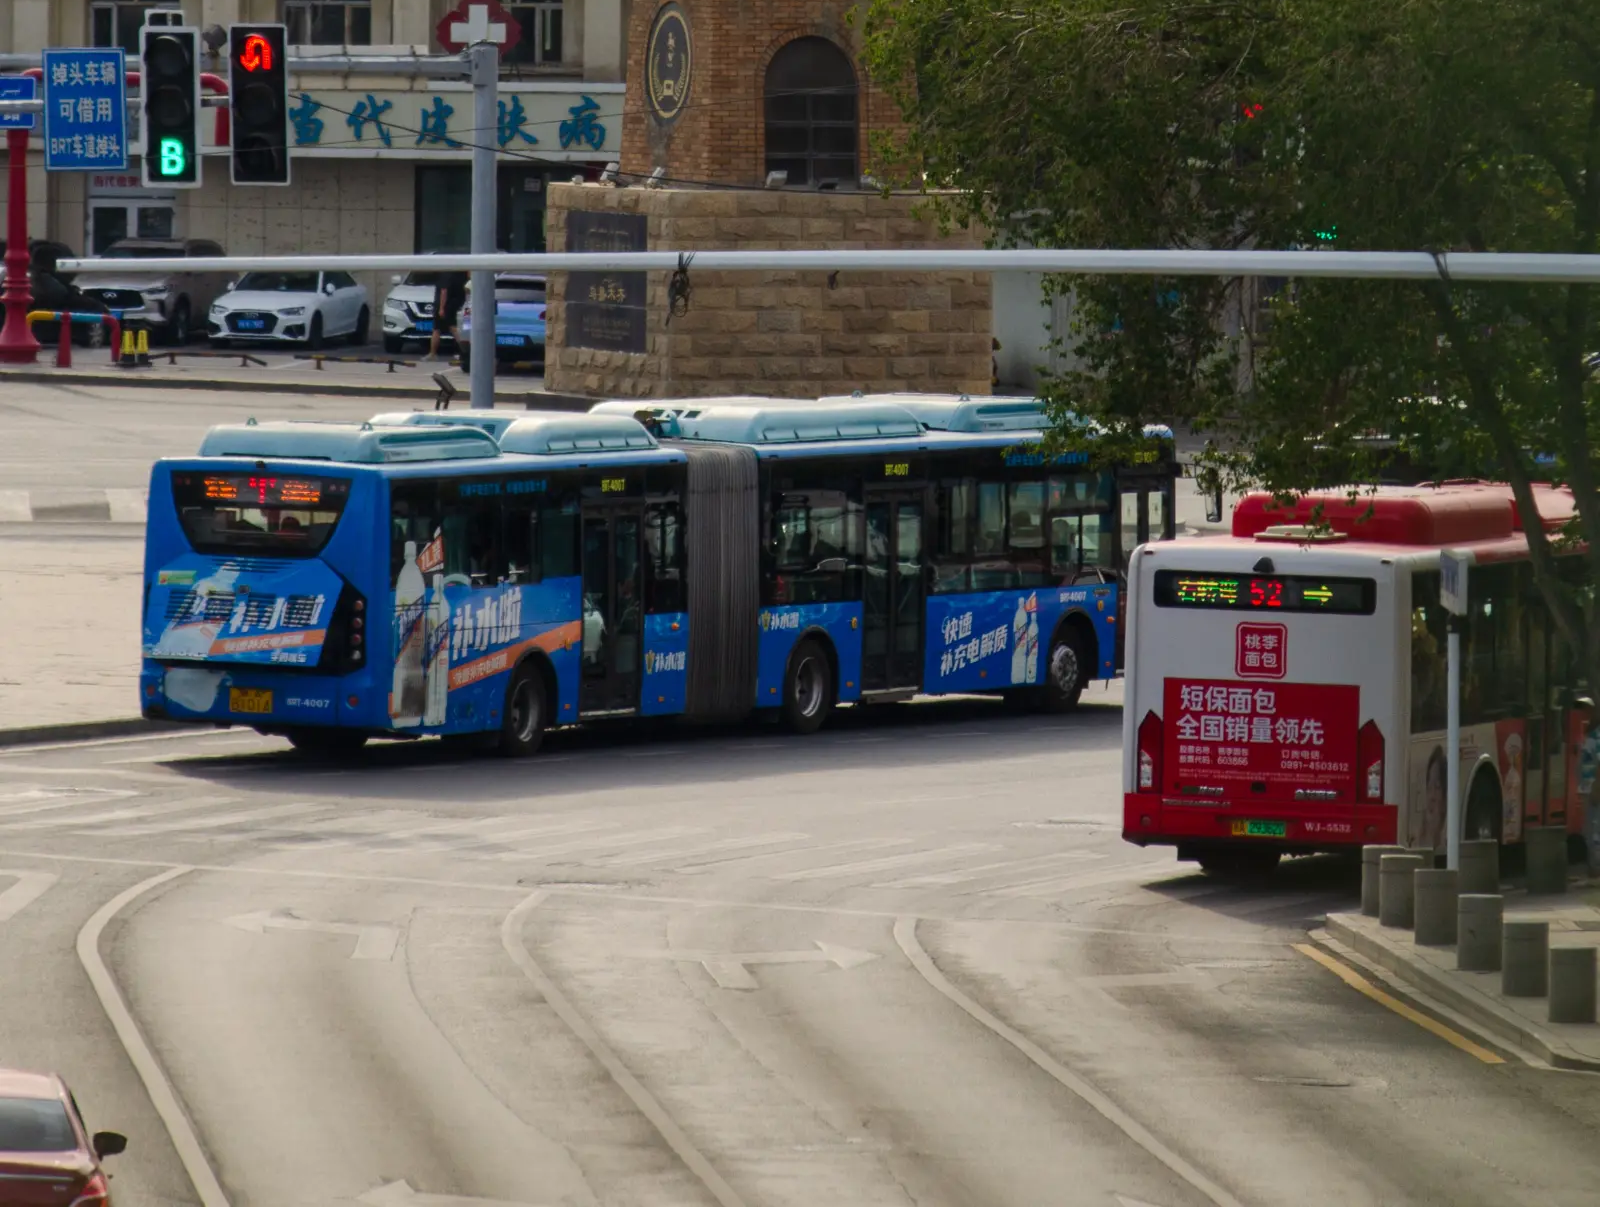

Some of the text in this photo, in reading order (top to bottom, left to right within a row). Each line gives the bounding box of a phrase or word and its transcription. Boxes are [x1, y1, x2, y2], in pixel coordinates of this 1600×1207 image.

[51, 60, 117, 87] 掉头车辆
[59, 97, 113, 123] 可借用
[51, 133, 120, 160] BRT车道掉头
[160, 138, 186, 175] B
[1250, 579, 1283, 606] 52
[943, 612, 973, 645] 快速
[1244, 633, 1279, 650] 桃李
[940, 624, 1009, 677] 补充电解质
[1244, 651, 1279, 668] 面包
[1180, 684, 1277, 715] 短保面包
[1176, 714, 1325, 746] 全国销量领先
